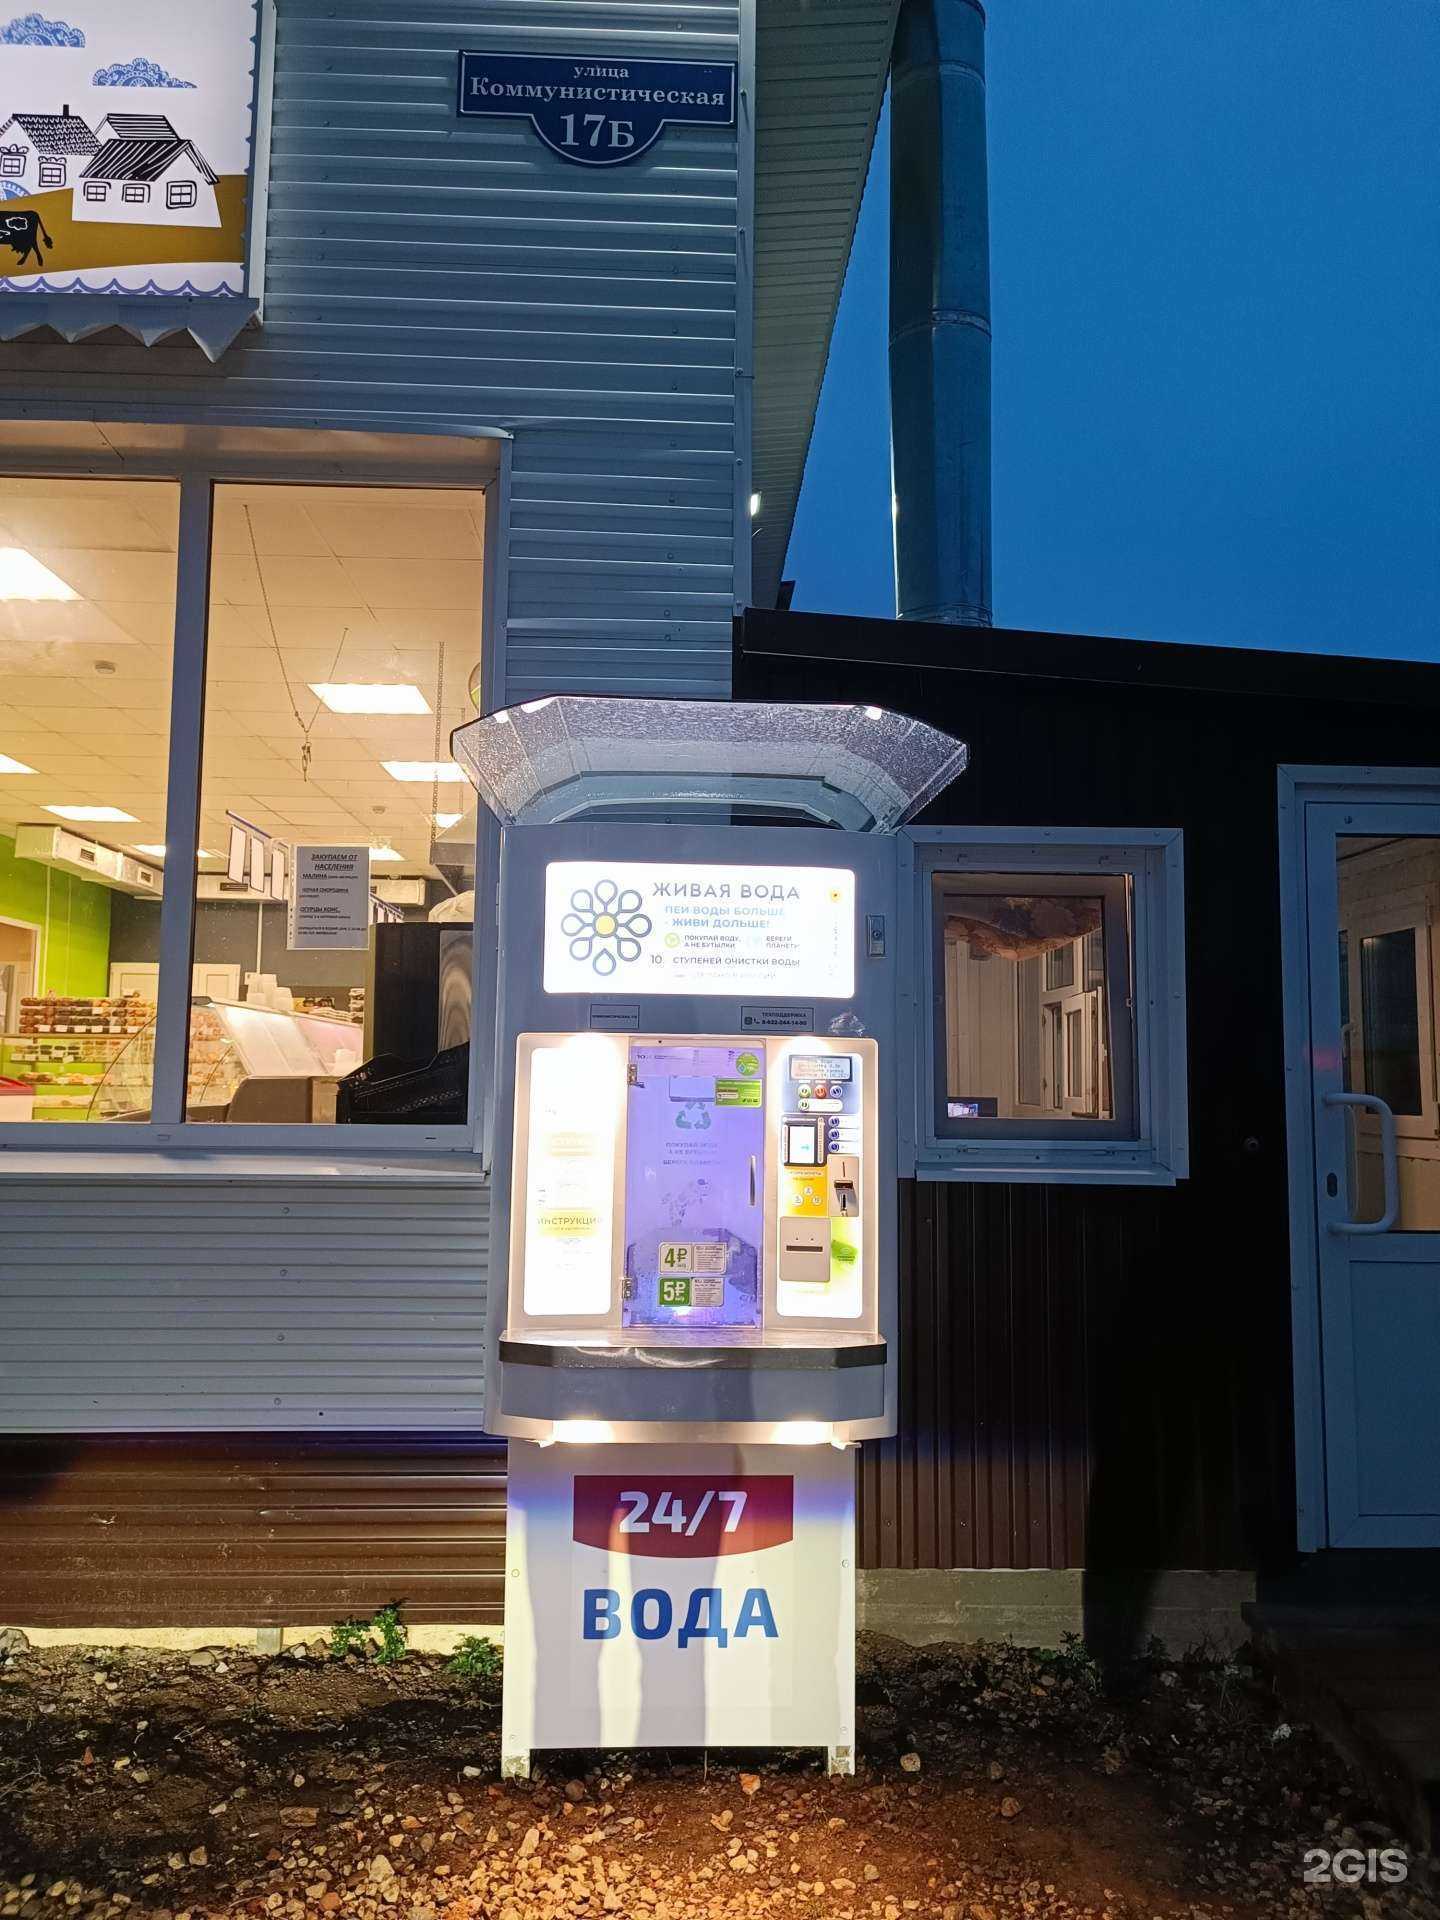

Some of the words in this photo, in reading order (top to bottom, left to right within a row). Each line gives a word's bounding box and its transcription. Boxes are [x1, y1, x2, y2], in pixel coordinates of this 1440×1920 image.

[574, 66, 629, 79] улица
[470, 77, 725, 106] Коммунистическая
[560, 113, 635, 148] 17Б
[311, 853, 347, 861] ЗАКУПАЕМ
[314, 863, 354, 871] НАСЕЛЕНИЯ
[652, 882, 731, 898] ЖИВАЯ
[741, 884, 800, 901] ВОДА
[693, 906, 730, 917] ВОДЫ
[672, 918, 709, 927] ЖИВИ
[651, 955, 663, 965] 10
[673, 955, 722, 965] СТУПЕНЕЙ
[724, 957, 769, 966] ОЧИСТКИ
[771, 958, 800, 967] ВОДЫ
[619, 1490, 748, 1537] 24/7
[583, 1588, 779, 1649] ВОДА
